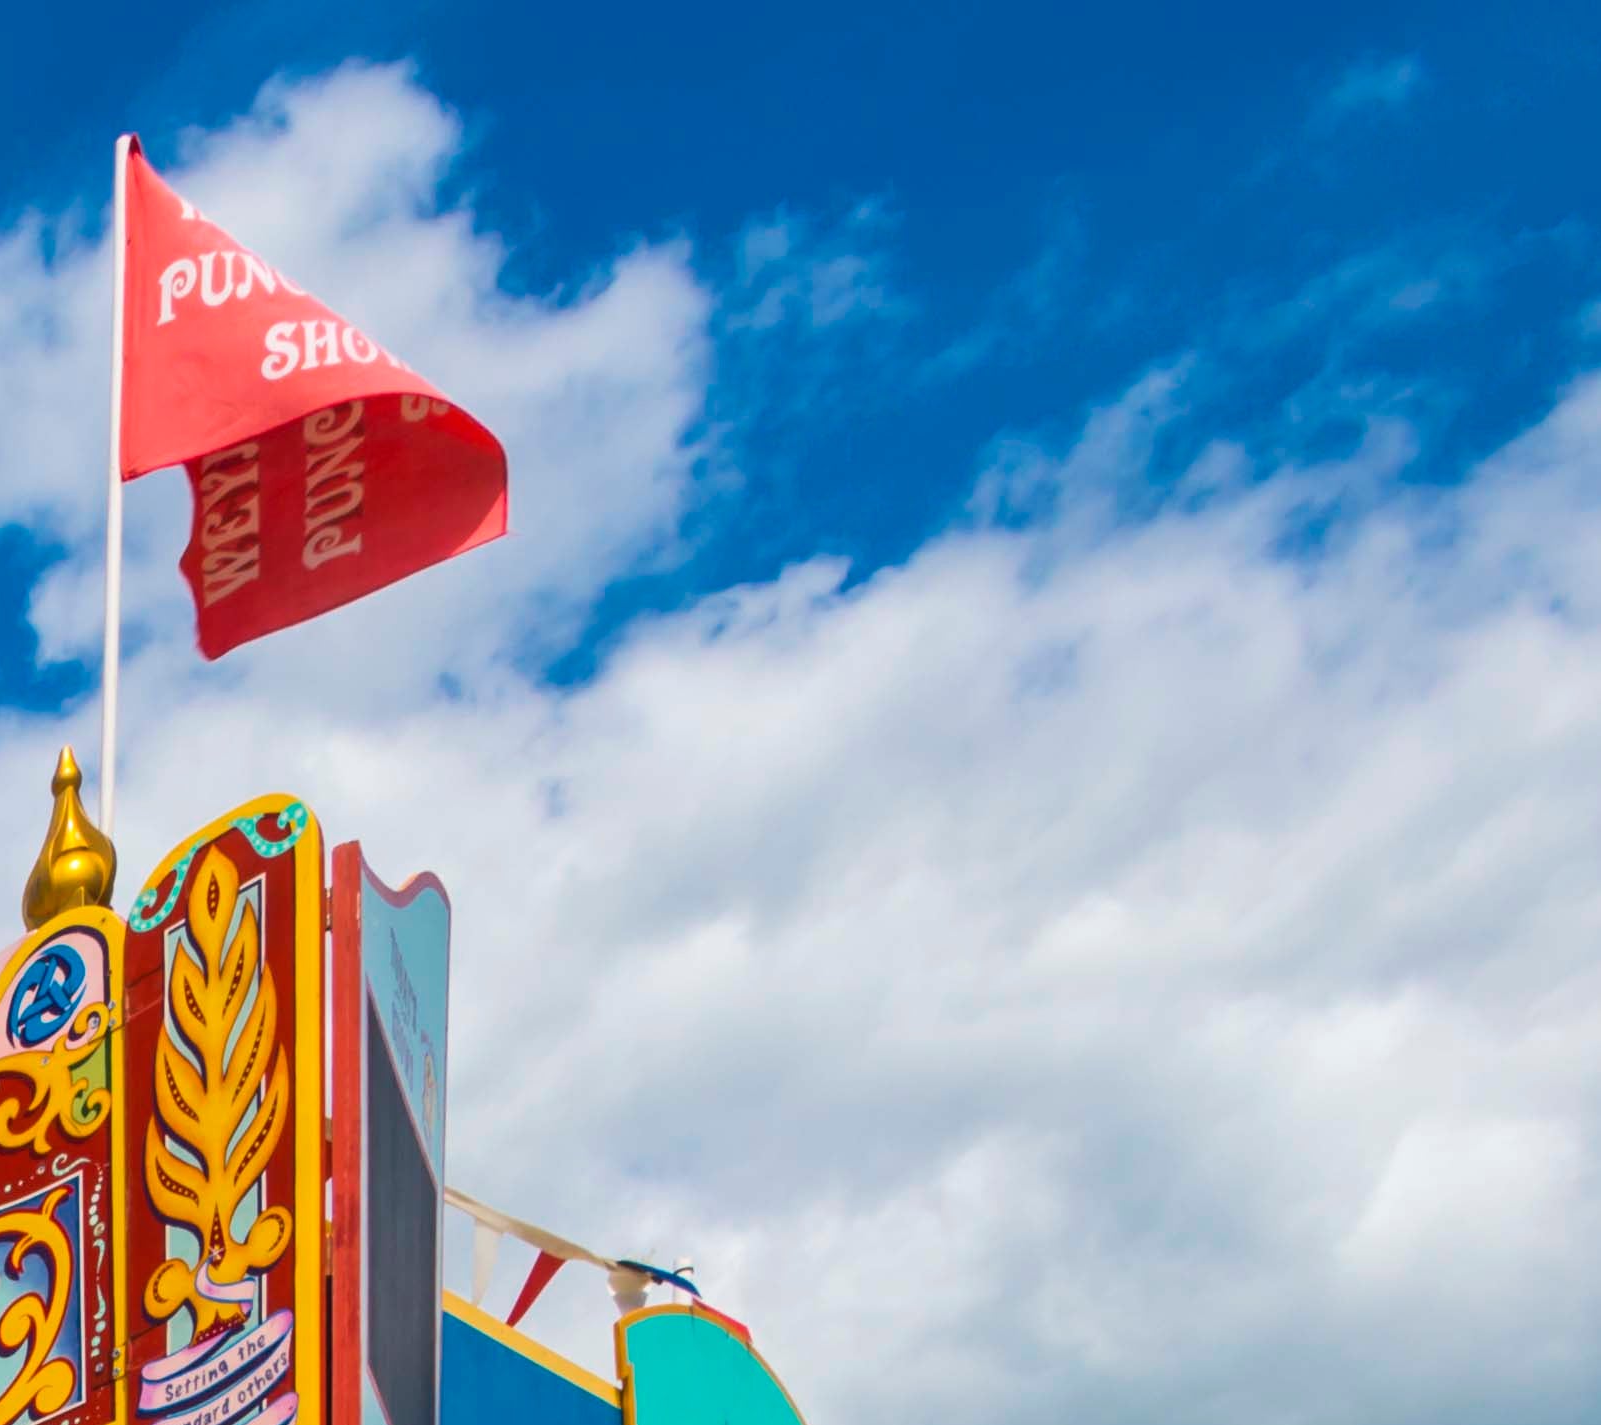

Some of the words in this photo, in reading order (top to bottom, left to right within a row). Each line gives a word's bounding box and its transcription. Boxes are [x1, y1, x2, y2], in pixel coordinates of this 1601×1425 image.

[164, 1358, 229, 1403] Setting
[236, 1333, 266, 1361] the
[236, 1351, 288, 1404] others
